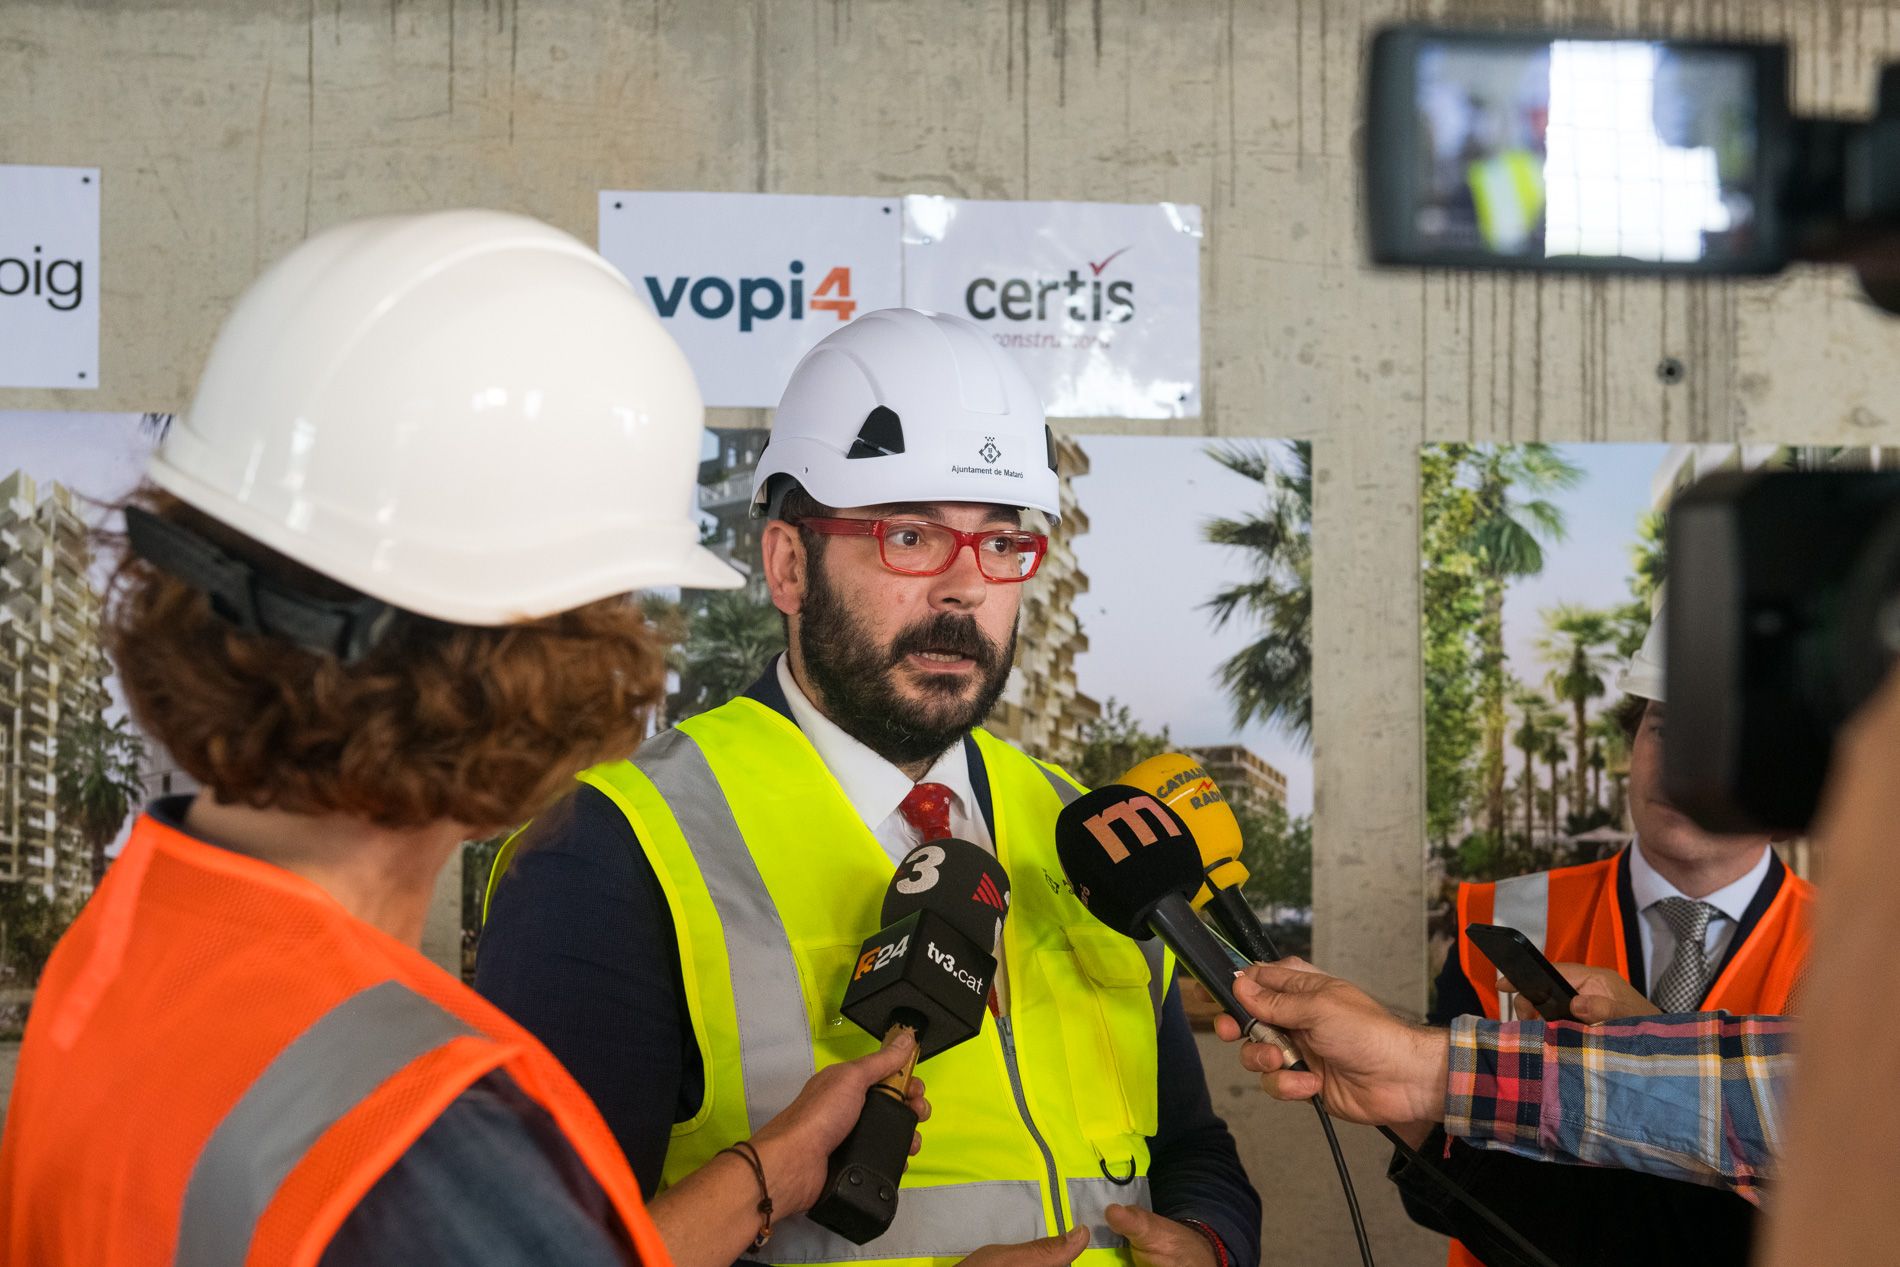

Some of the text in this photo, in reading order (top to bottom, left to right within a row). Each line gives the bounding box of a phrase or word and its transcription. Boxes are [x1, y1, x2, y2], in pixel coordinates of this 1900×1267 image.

[643, 260, 857, 332] vopi4
[965, 263, 1135, 323] certis
[951, 465, 1024, 479] Ajuntament de Mataró
[1082, 795, 1183, 865] m
[896, 845, 946, 895] 3
[927, 941, 984, 995] tv3.cat
